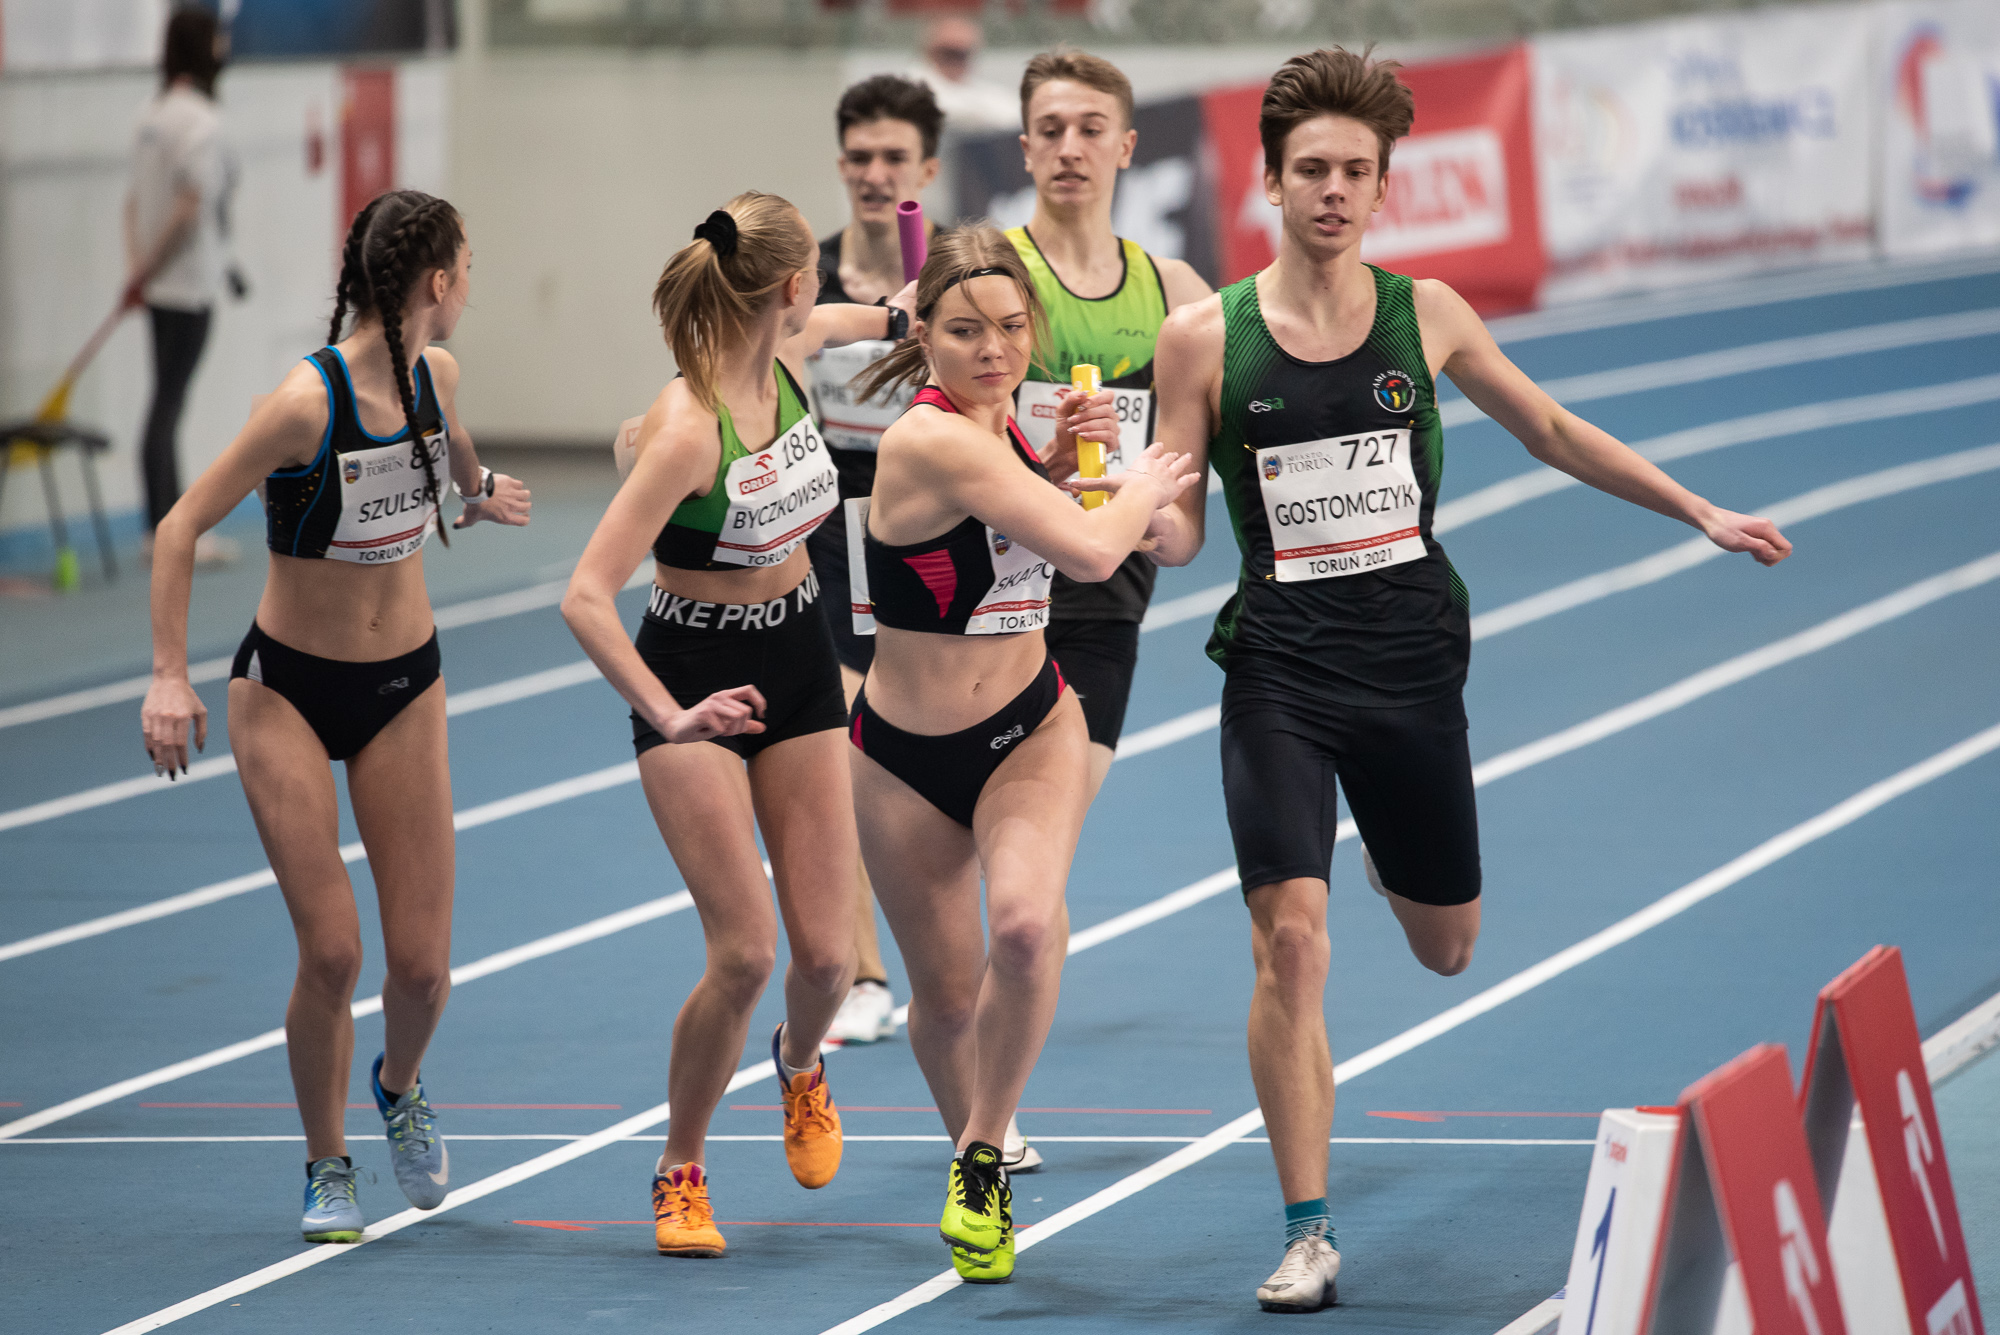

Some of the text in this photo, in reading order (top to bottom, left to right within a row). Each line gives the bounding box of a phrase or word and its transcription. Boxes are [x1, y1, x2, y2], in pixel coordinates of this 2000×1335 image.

[1249, 397, 1285, 413] esa
[782, 424, 818, 470] 186
[1287, 451, 1323, 462] MIASTO
[1340, 433, 1398, 471] 727
[740, 471, 777, 494] ORLEN
[733, 469, 835, 529] BYCZKOWSKA
[1275, 483, 1415, 527] GOSTOMCZYK
[1309, 548, 1393, 575] TORUŃ 2021
[648, 583, 716, 629] NIKE
[717, 597, 787, 631] PRO
[989, 724, 1025, 750] esa
